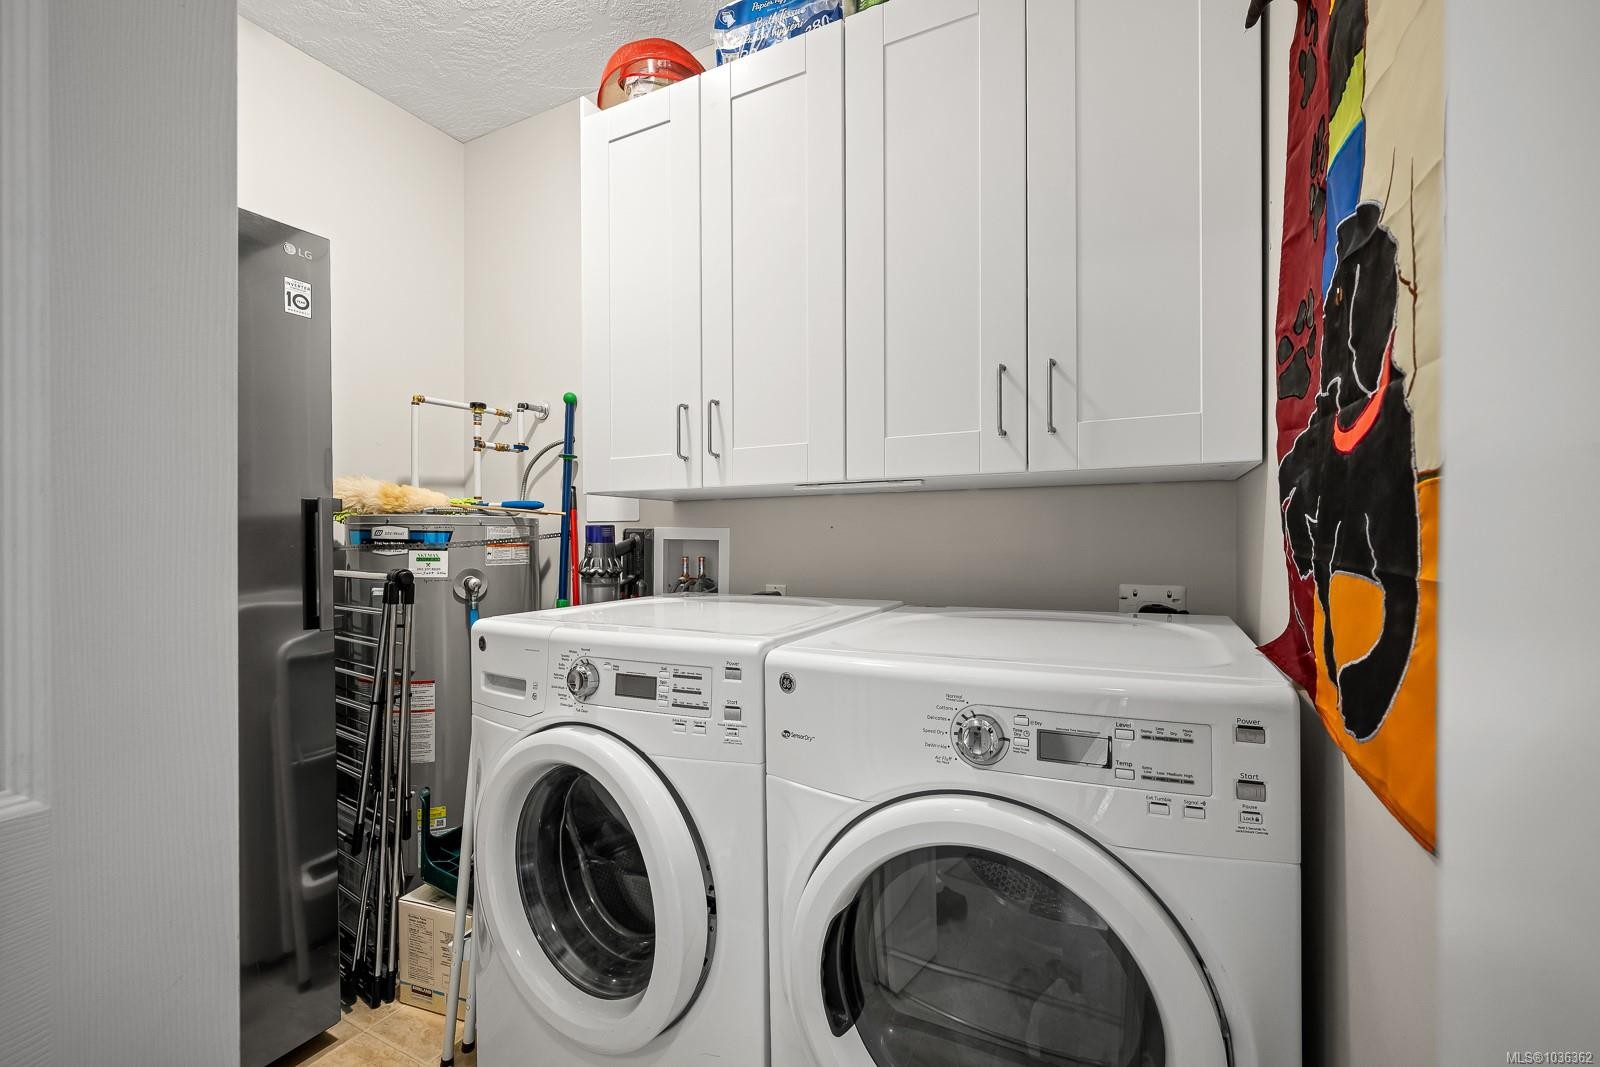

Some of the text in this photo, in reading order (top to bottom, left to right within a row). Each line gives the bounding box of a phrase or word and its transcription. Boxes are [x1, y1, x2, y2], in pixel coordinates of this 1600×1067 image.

[298, 248, 313, 260] LG
[286, 291, 310, 311] 10
[1236, 718, 1262, 726] Power
[1239, 772, 1260, 780] Start
